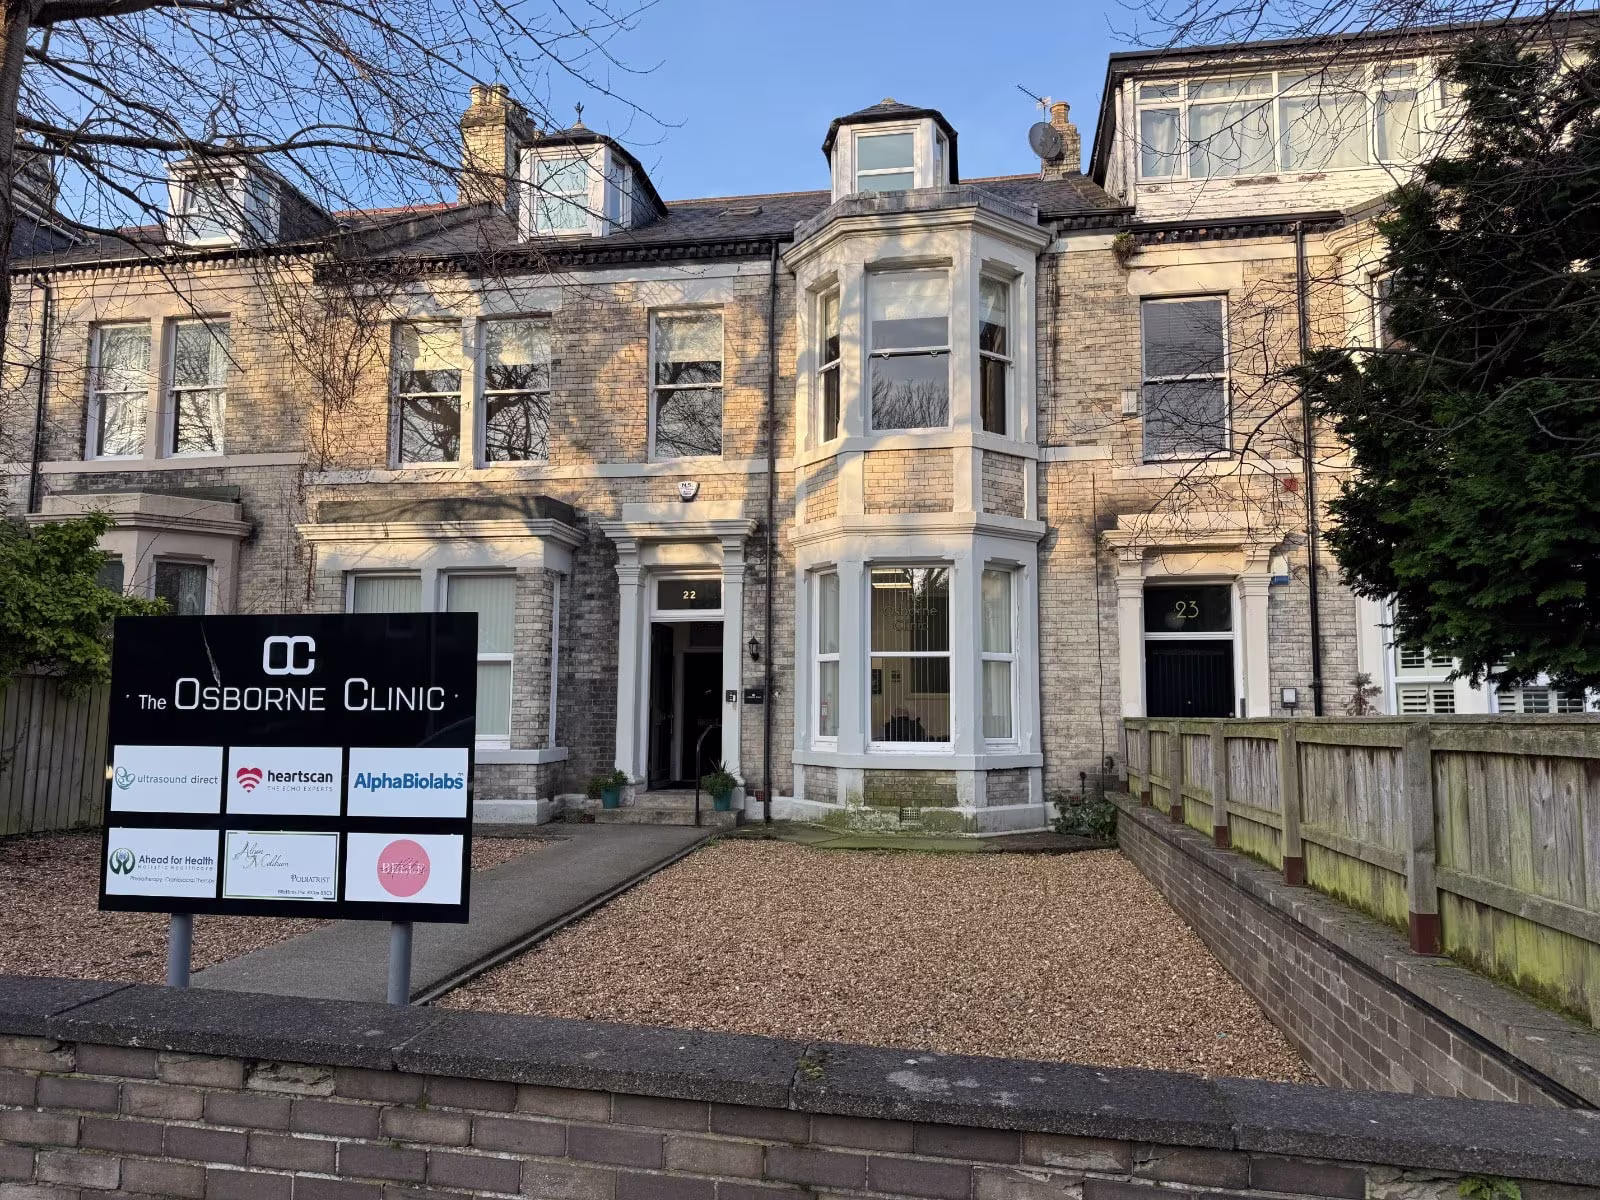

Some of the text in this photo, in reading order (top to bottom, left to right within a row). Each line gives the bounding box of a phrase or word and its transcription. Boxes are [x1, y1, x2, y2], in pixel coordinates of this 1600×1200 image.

[683, 590, 696, 600] 22
[1175, 600, 1199, 618] 23
[138, 677, 445, 711] The OSBORNE CLINIC
[137, 774, 219, 785] ultrasound direct
[267, 769, 333, 783] heartscan
[138, 854, 214, 865] Ahead for Health
[290, 874, 331, 884] PODIATRIST
